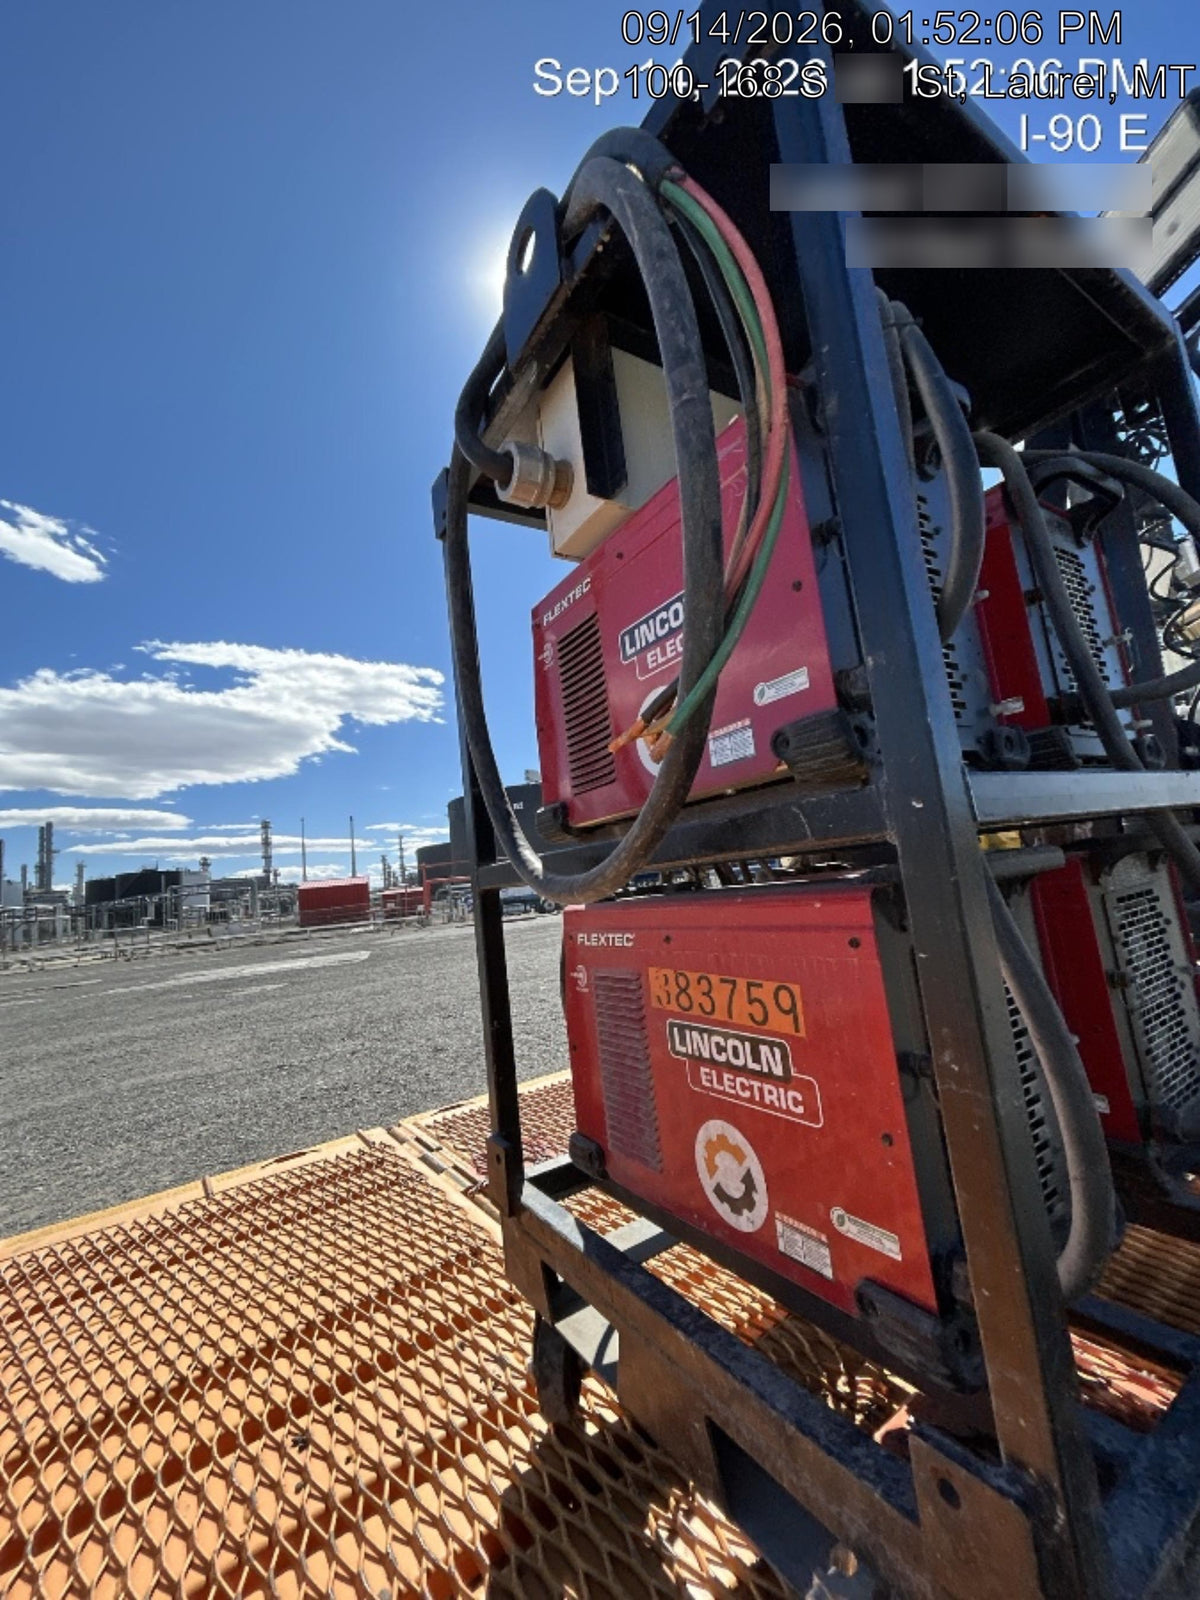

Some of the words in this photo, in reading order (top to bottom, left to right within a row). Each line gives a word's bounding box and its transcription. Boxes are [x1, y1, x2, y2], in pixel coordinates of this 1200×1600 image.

[543, 577, 592, 627] FLEXTEC
[623, 599, 685, 657] LINCO
[577, 932, 636, 947] FLEXTEC
[655, 971, 801, 1034] 383759
[673, 1026, 784, 1077] LINCOLN
[699, 1065, 805, 1114] ELECTRIC
